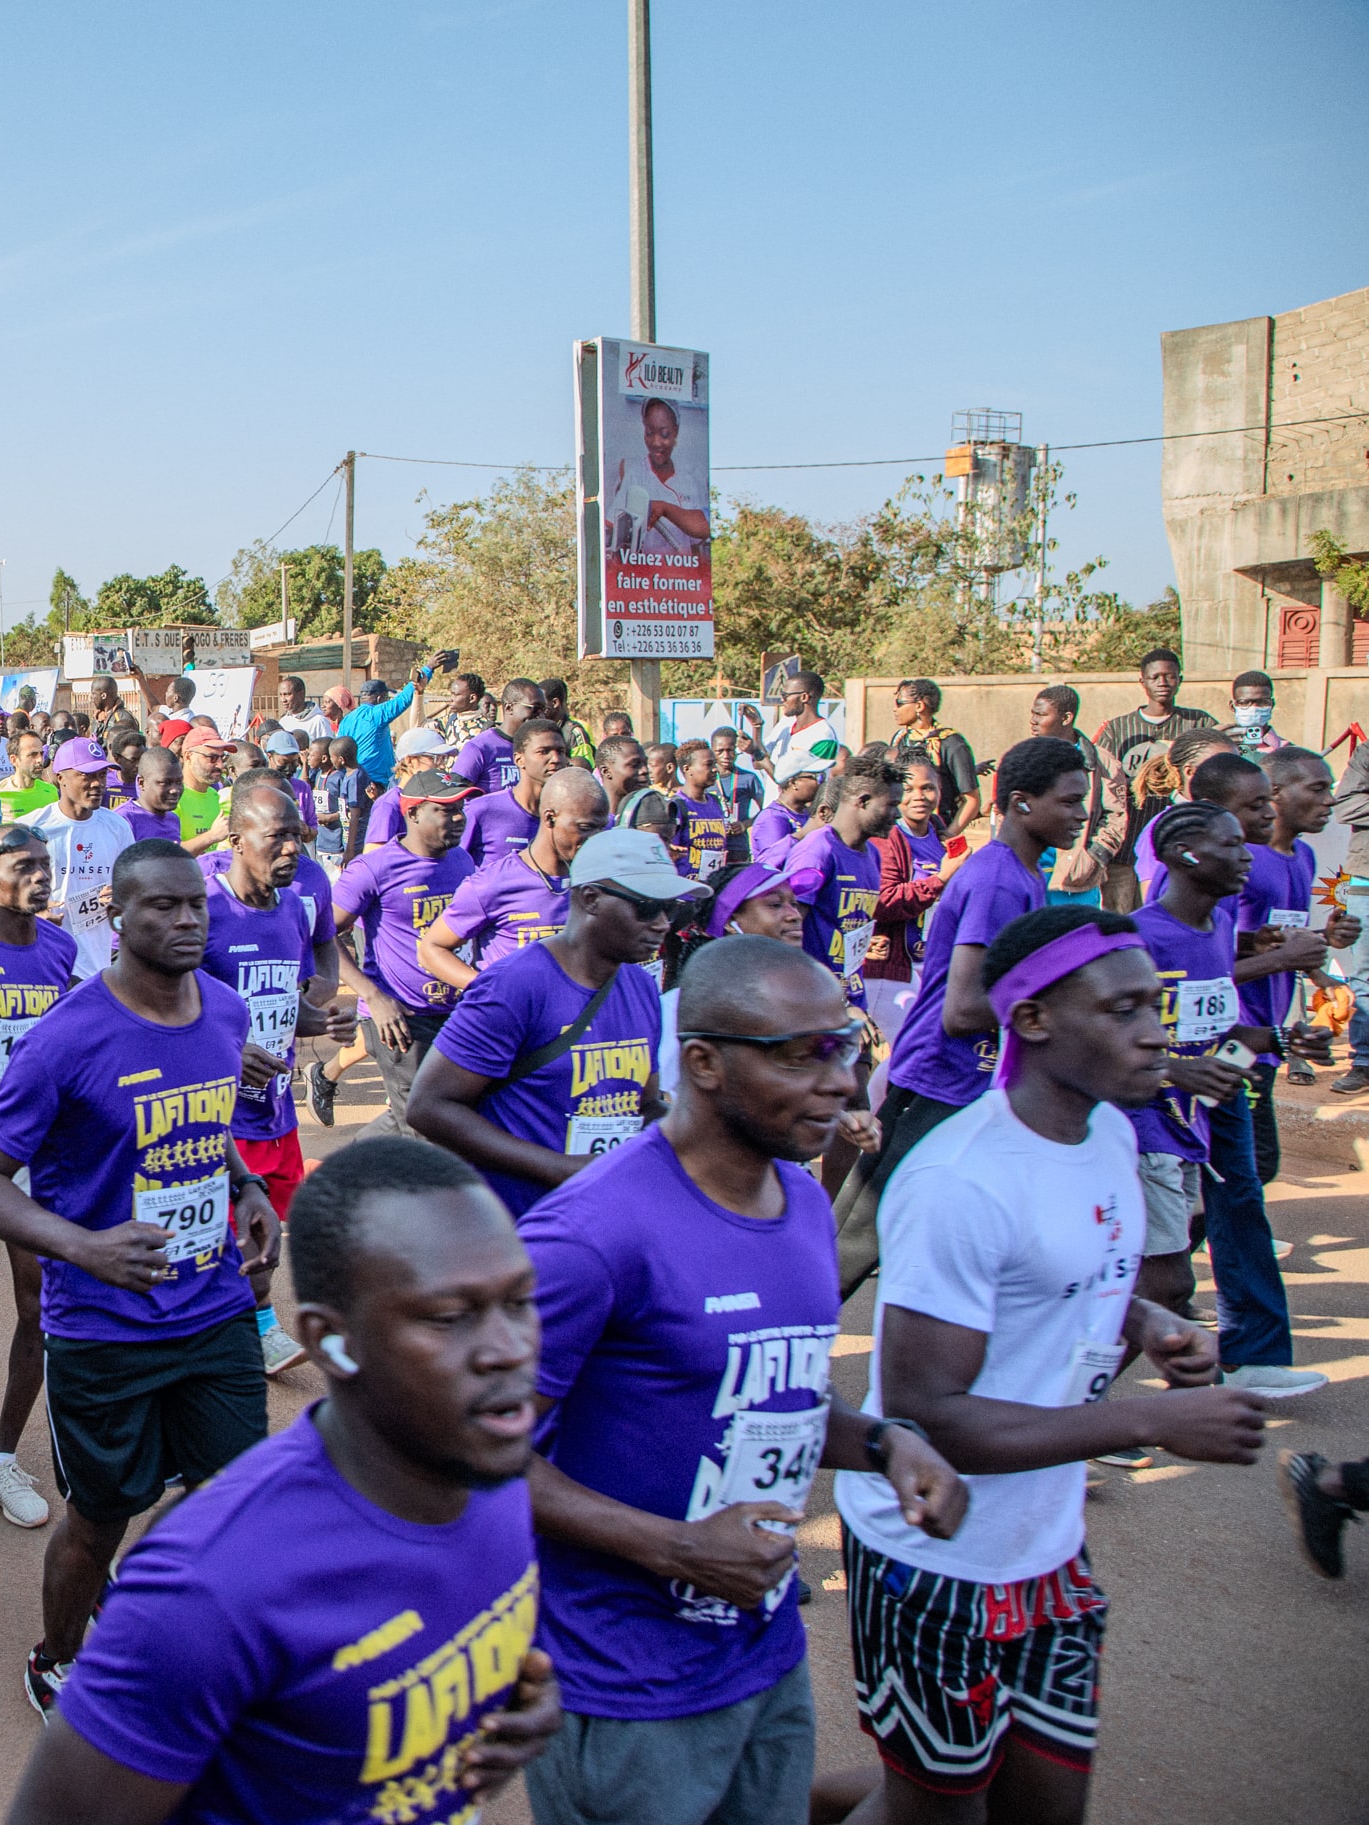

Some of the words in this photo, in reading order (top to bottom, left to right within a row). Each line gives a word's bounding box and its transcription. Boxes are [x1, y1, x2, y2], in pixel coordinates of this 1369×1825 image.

[658, 365, 684, 386] BEAUTY
[619, 548, 662, 567] Venez
[665, 554, 699, 568] vous
[616, 571, 650, 590] faire
[652, 573, 702, 592] former
[607, 600, 625, 613] en
[628, 598, 706, 619] esthétique
[212, 632, 219, 647] &
[220, 632, 249, 647] FRERES
[631, 624, 652, 637] +226
[653, 624, 664, 637] 53
[665, 625, 676, 637] 02
[677, 625, 688, 637] 07
[689, 625, 700, 637] 87
[632, 641, 653, 653] +226
[655, 641, 666, 653] 25
[668, 641, 678, 653] 36
[680, 641, 690, 653] 36
[692, 641, 702, 653] 36
[61, 865, 111, 875] SUNSET
[237, 964, 271, 1000] LAFI
[256, 1006, 296, 1033] 1148
[135, 1094, 184, 1150] LAFI
[158, 1198, 214, 1230] 790
